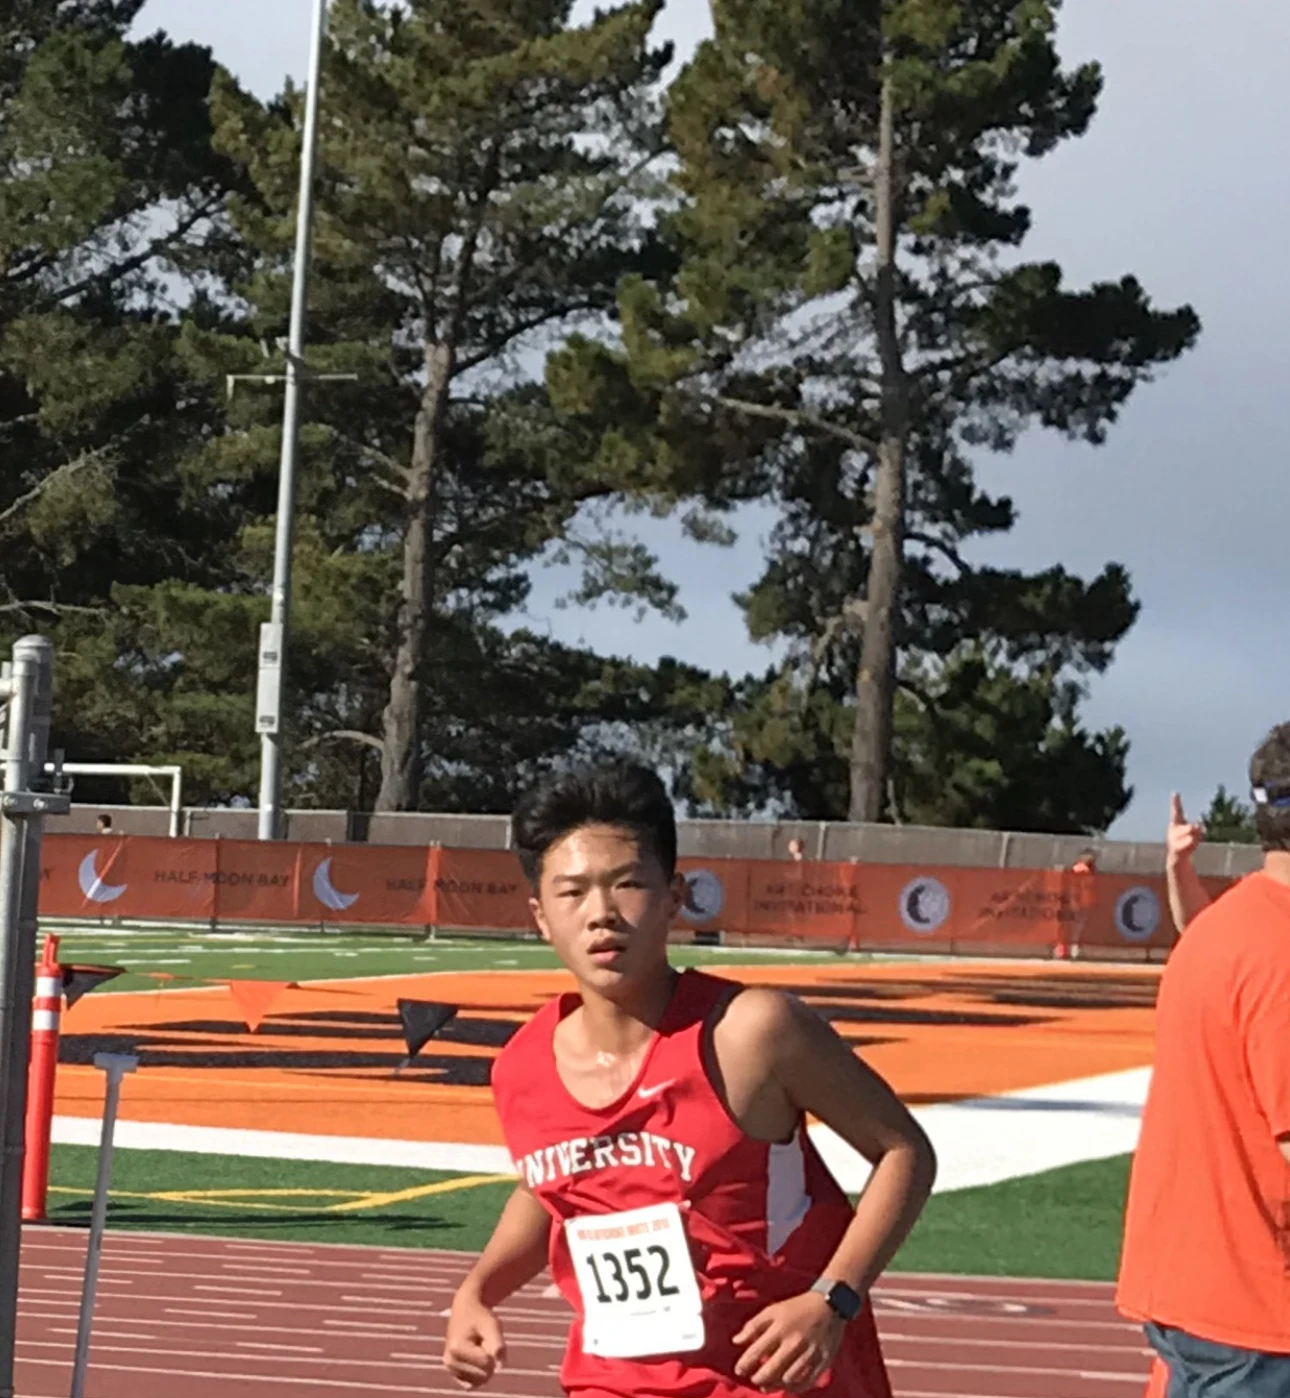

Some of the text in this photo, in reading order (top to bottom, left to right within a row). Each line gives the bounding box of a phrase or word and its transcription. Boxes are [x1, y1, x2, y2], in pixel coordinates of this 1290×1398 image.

[153, 870, 291, 887] HALF MOON BAY
[586, 1244, 680, 1303] 1352
